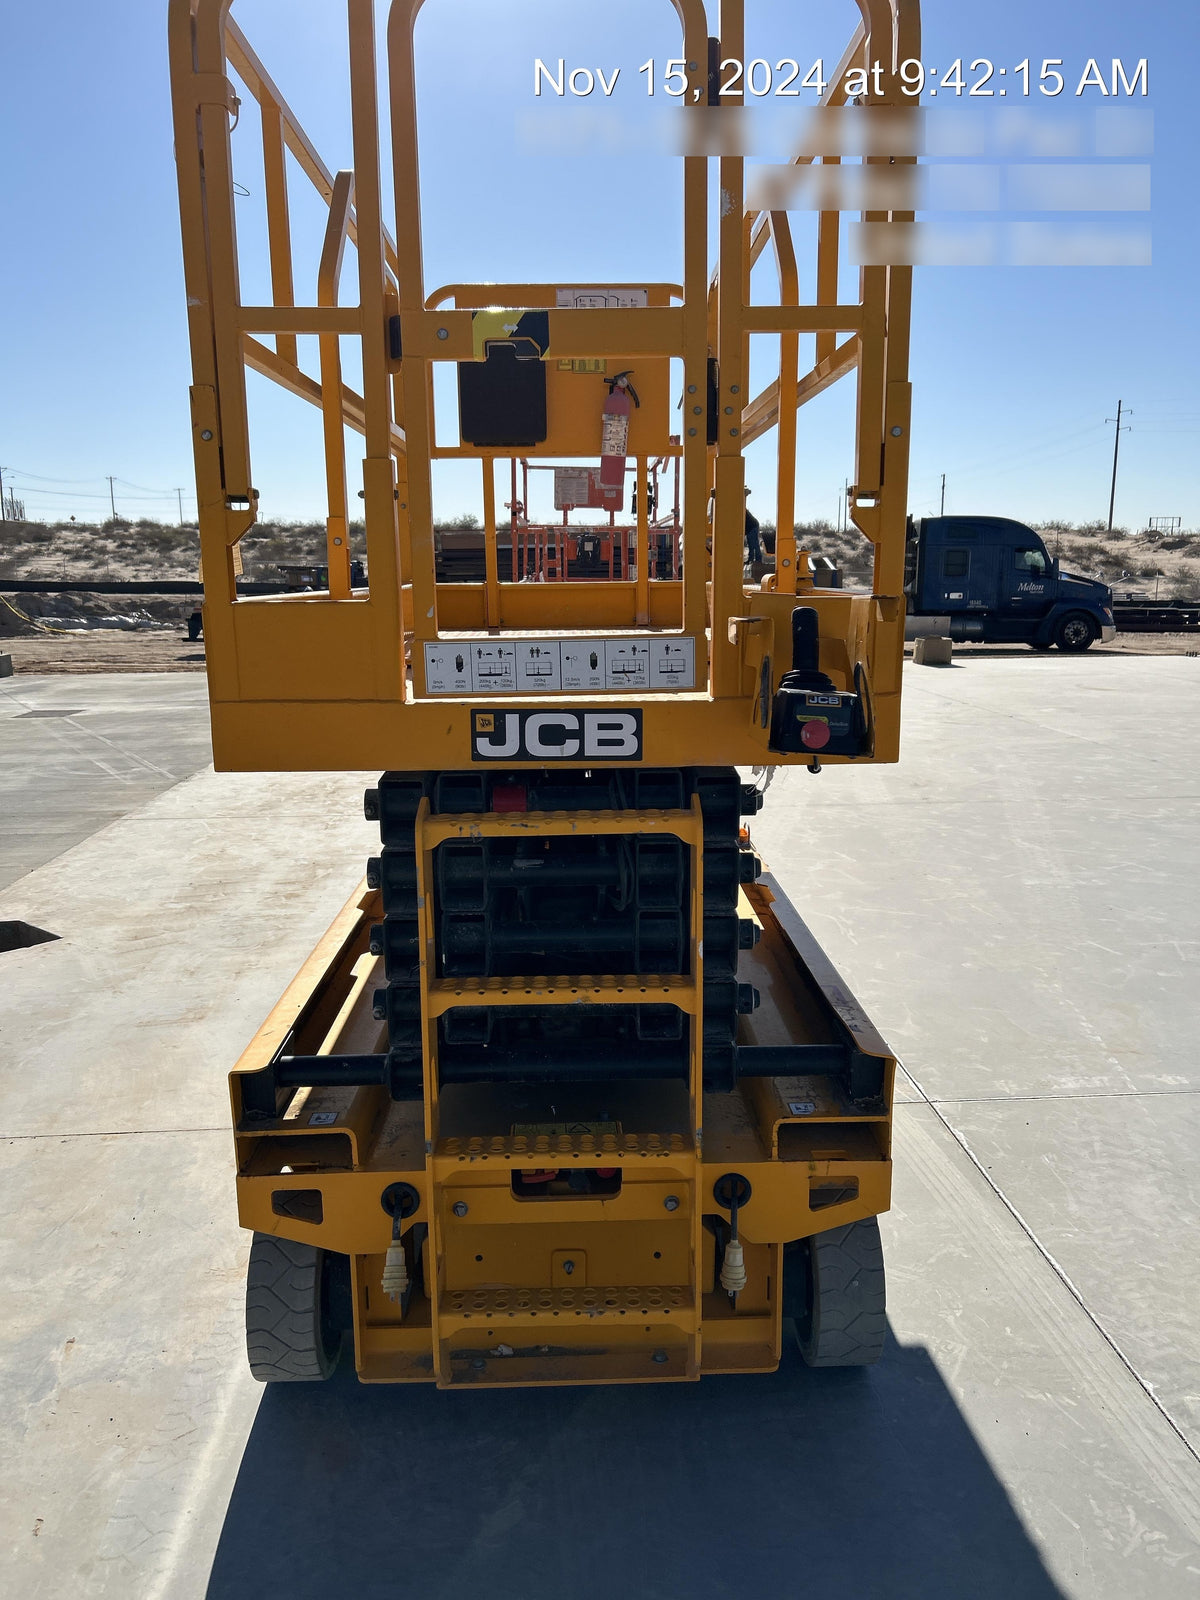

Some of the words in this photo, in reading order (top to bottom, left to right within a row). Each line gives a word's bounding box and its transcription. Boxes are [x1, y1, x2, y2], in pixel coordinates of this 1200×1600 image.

[1017, 582, 1045, 592] Melton
[808, 696, 840, 705] JCB
[475, 713, 639, 757] JCB
